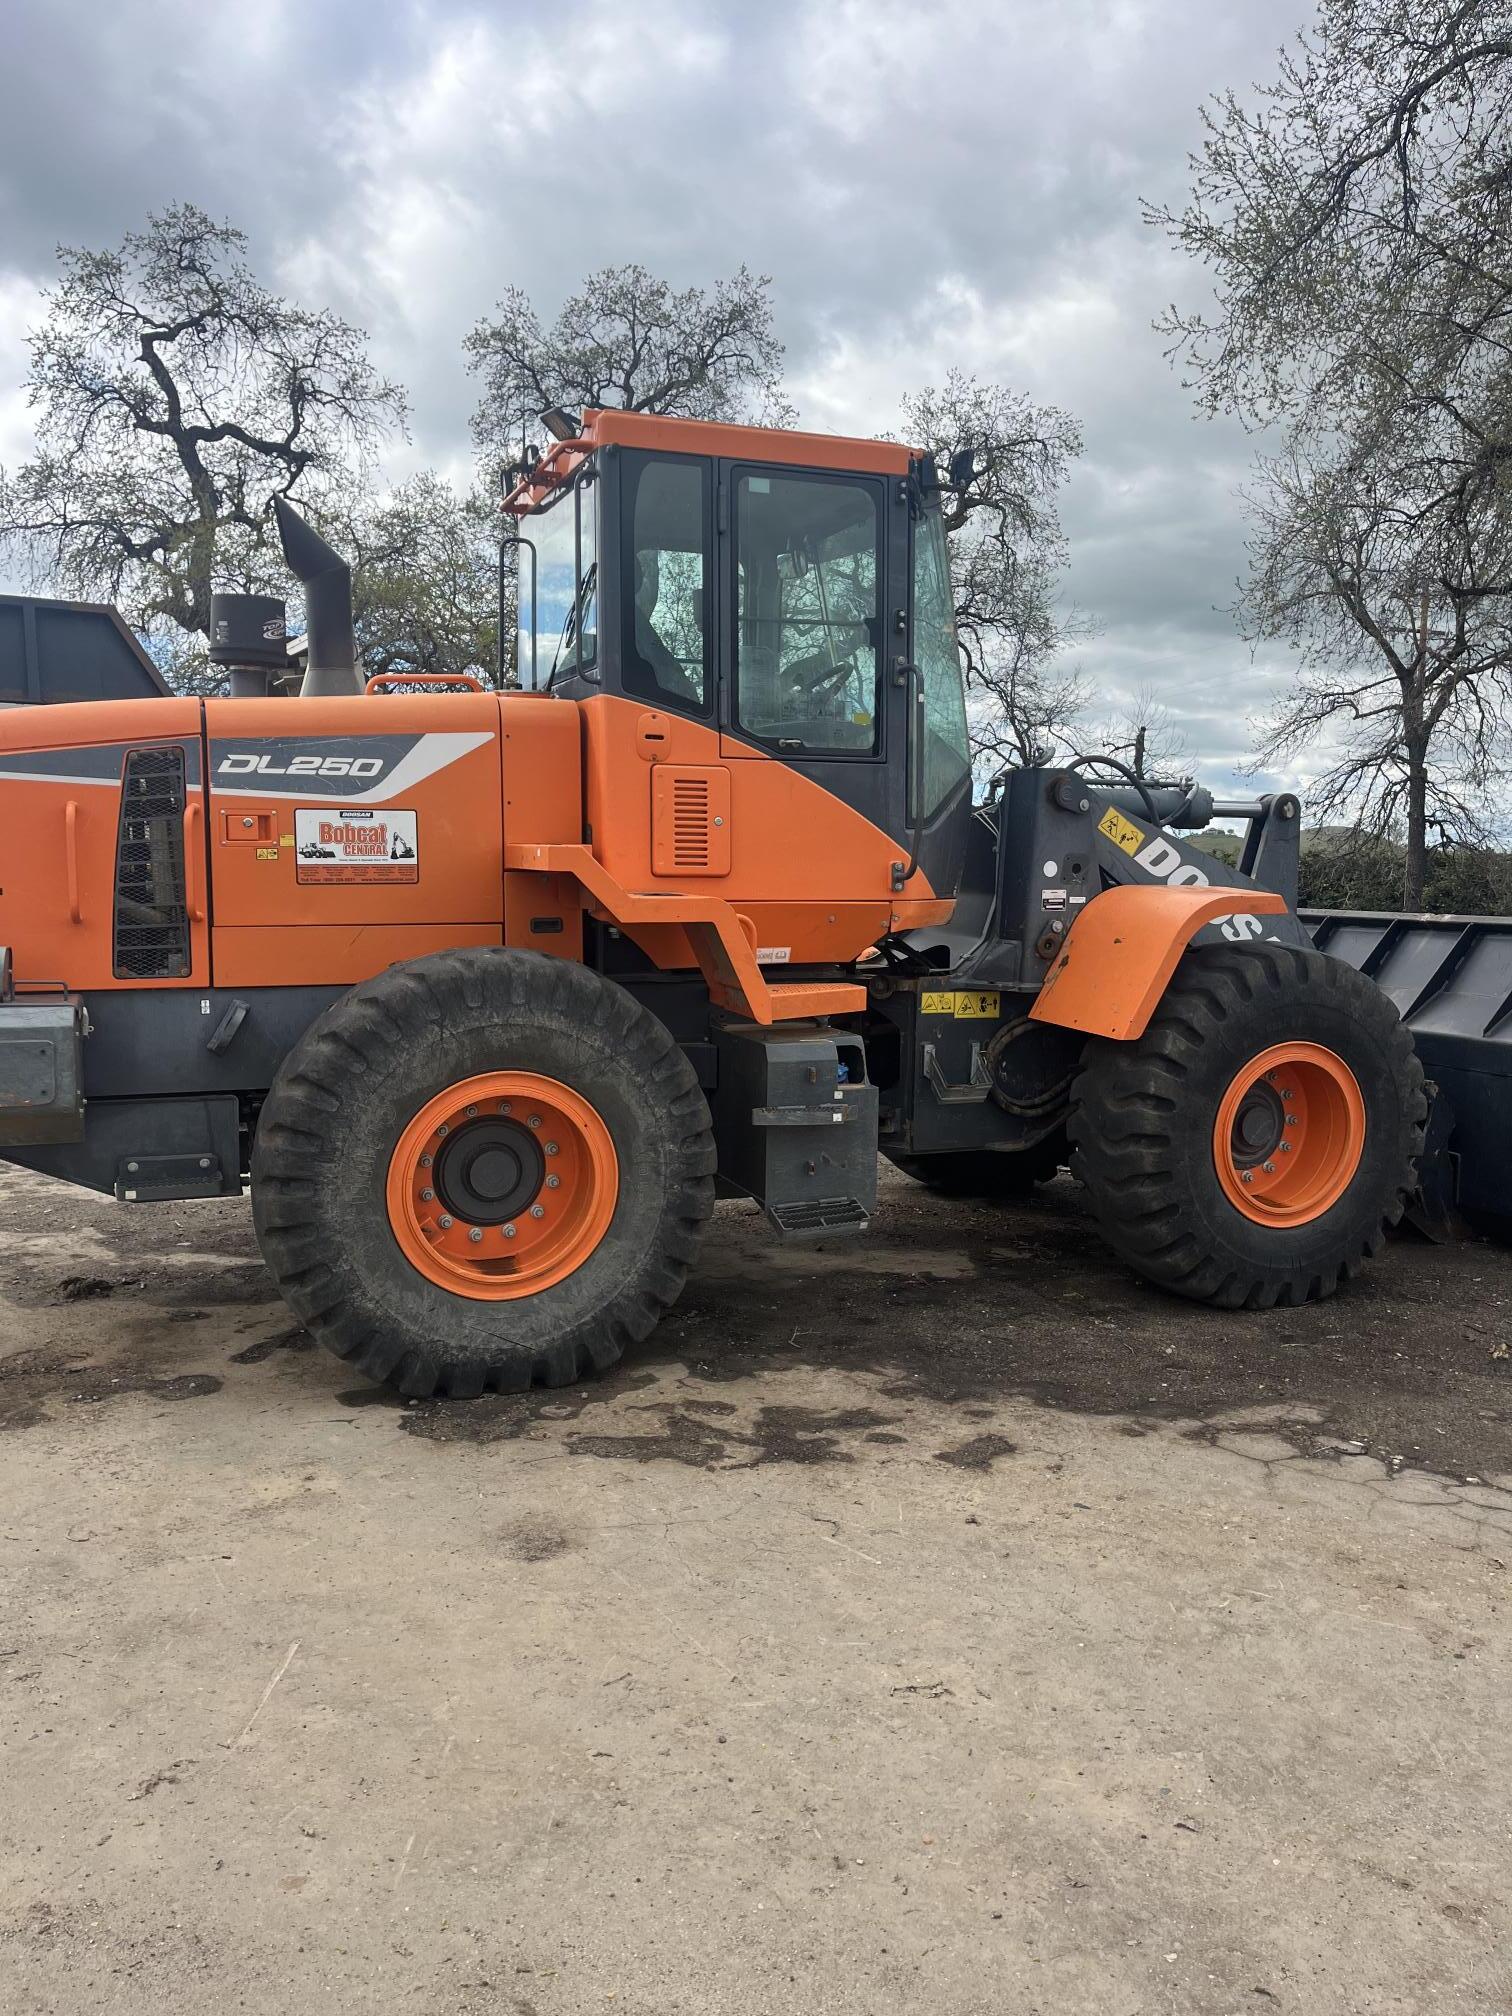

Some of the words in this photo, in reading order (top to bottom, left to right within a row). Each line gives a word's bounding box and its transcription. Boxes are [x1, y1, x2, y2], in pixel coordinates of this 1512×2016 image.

[217, 754, 384, 777] DL250
[319, 822, 387, 844] Bobcat
[343, 844, 388, 856] CENTRAL
